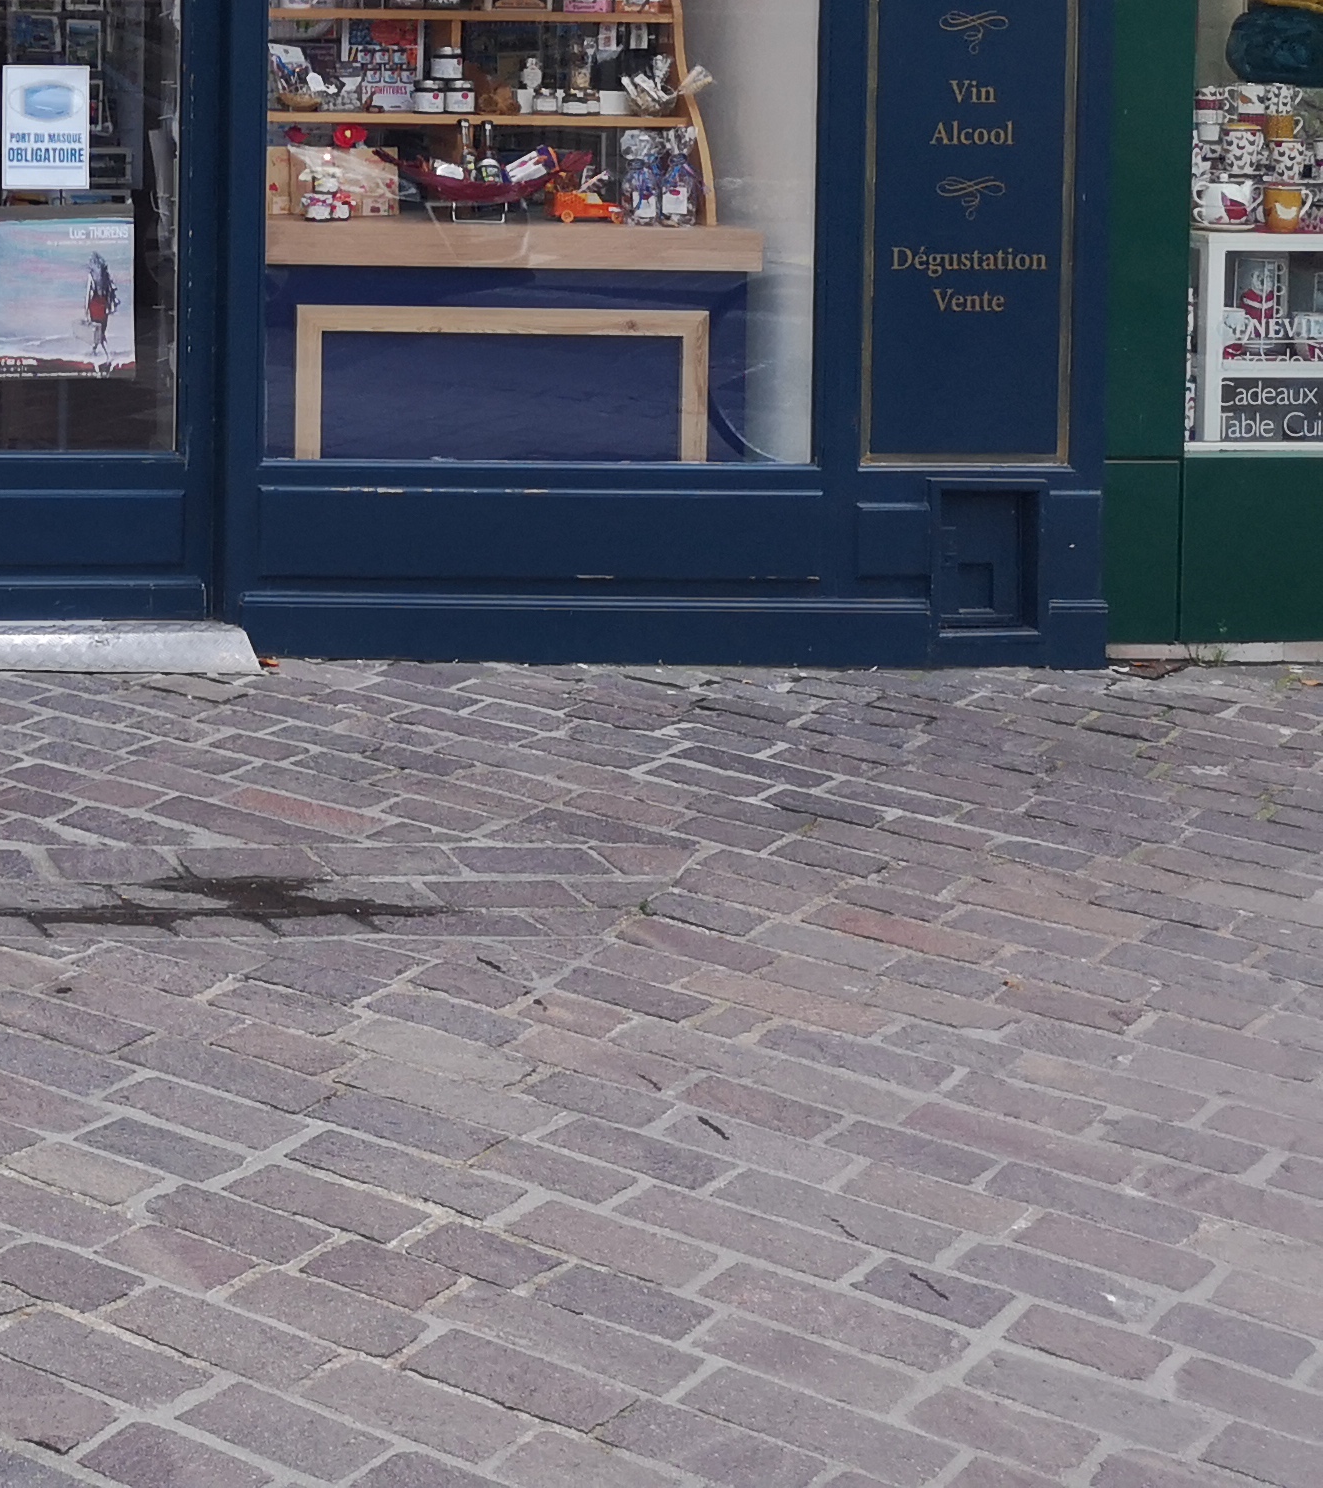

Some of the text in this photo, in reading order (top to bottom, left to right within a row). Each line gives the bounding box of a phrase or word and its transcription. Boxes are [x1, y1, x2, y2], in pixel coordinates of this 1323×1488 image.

[949, 80, 996, 104] Vin
[10, 132, 82, 143] PORT DU MASQUE
[929, 121, 1014, 146] Alcool
[8, 147, 85, 163] OBLIGATOIRE
[89, 226, 129, 238] THORENS
[891, 246, 1047, 275] Dégustation
[933, 288, 1005, 312] Vente
[1221, 381, 1318, 407] Cadeaux
[1220, 412, 1274, 439] Table
